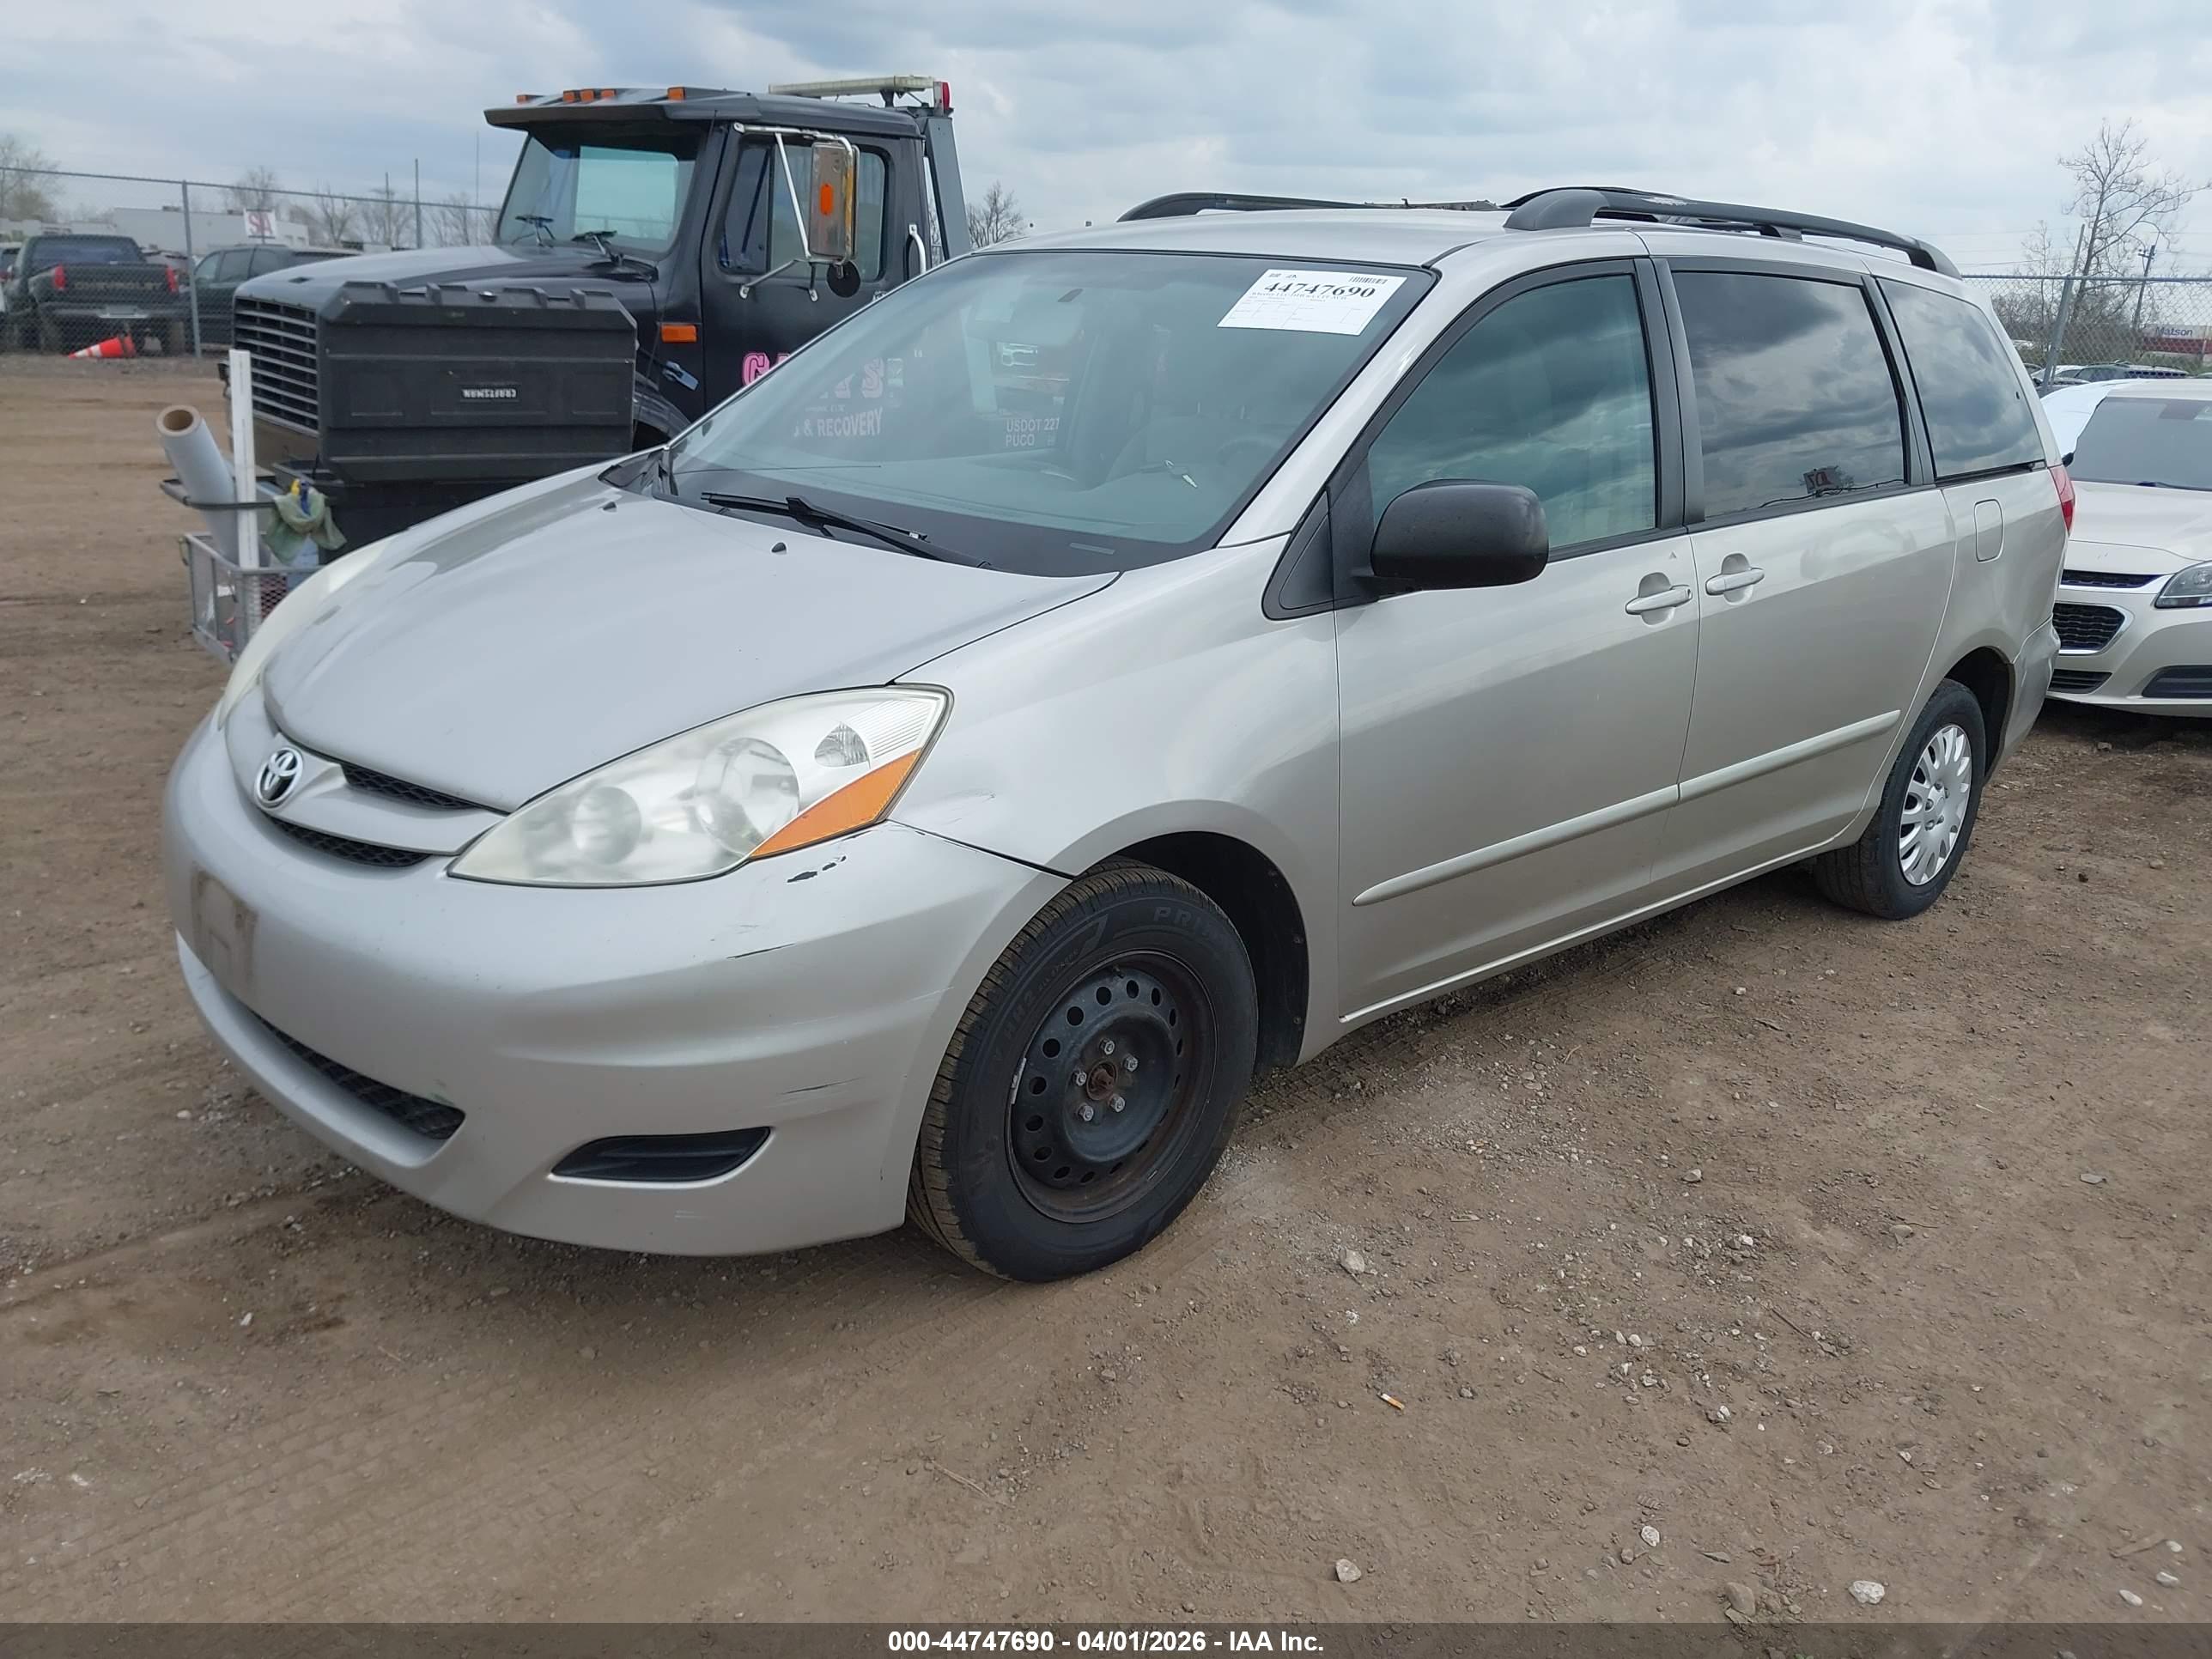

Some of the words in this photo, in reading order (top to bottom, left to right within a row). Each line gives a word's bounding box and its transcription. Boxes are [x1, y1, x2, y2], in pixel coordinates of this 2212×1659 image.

[1264, 282, 1376, 298] 44747690
[2156, 326, 2193, 337] Matson
[817, 408, 884, 437] RECOVERY
[1006, 419, 1042, 433] USDOT
[1006, 434, 1036, 447] PUCO
